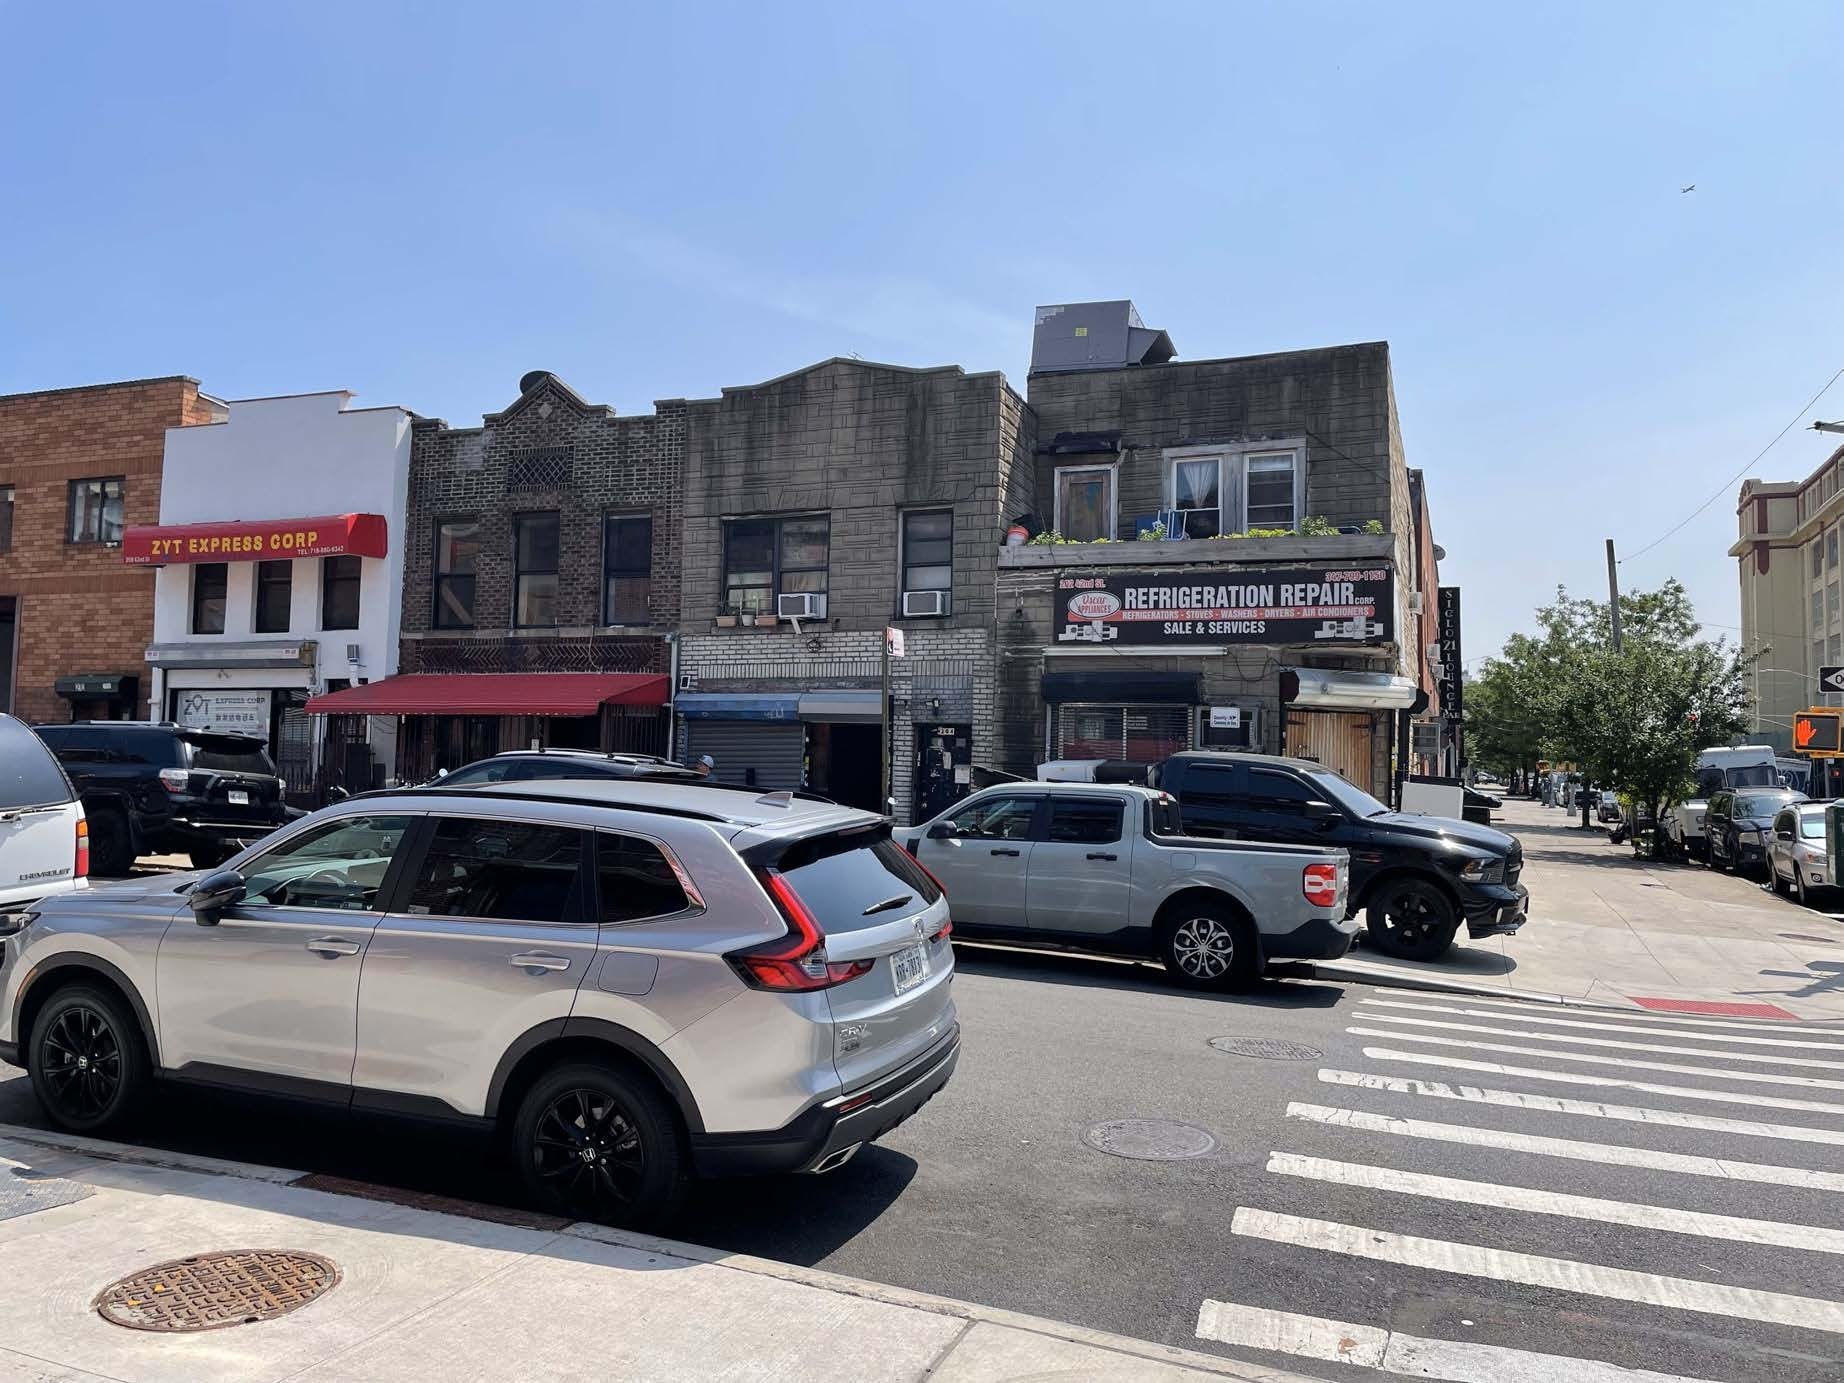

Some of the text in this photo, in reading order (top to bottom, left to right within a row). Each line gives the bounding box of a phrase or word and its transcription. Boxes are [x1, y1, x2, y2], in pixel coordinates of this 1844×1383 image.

[151, 531, 318, 555] ZYT EXPRESS CORP
[1125, 582, 1376, 608] REFRIGERATION REPAIR CORP.
[1122, 610, 1179, 620] REFRIGERATORS
[1186, 609, 1214, 619] STOVES
[1221, 608, 1258, 618] WASHERS
[1265, 608, 1294, 618] DRYERS
[1302, 607, 1316, 616] AIR
[1164, 621, 1266, 634] SALE & SERVICES
[1443, 640, 1456, 650] 21
[20, 868, 70, 880] CHEVROLET
